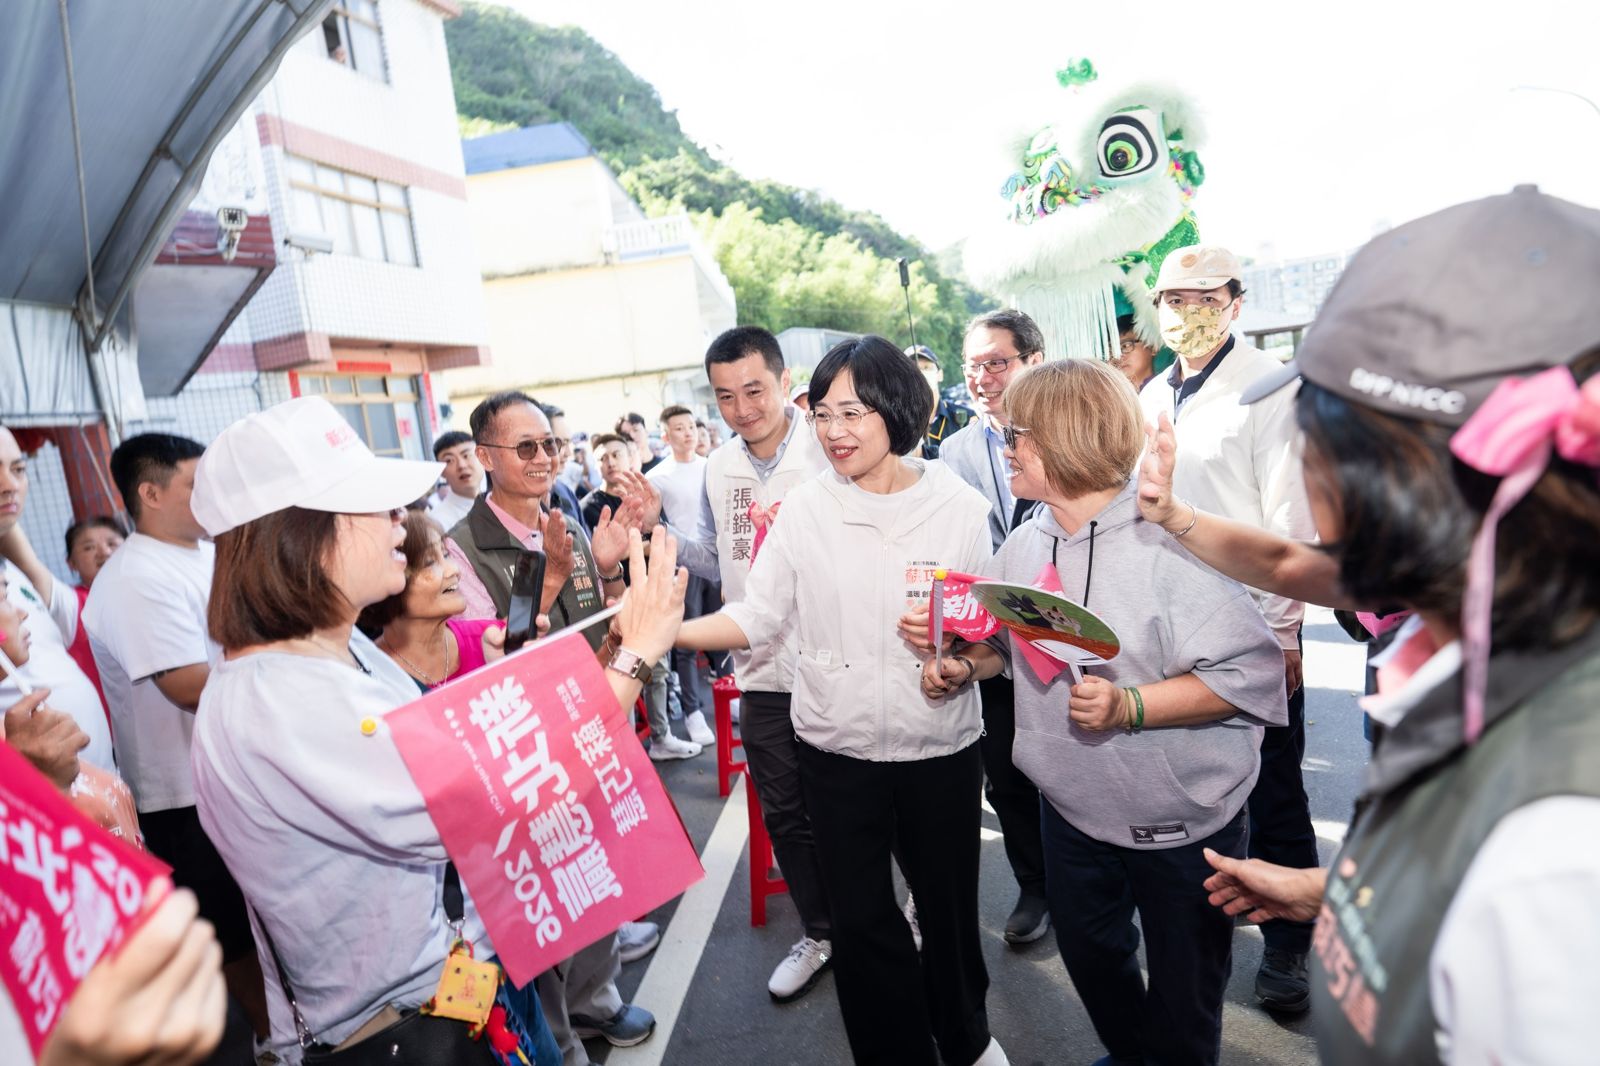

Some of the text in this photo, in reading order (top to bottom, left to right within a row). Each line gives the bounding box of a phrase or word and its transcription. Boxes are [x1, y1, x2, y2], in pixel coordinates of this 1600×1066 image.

[733, 488, 752, 560] 張錦豪
[10, 907, 66, 1034] 蘇巧
